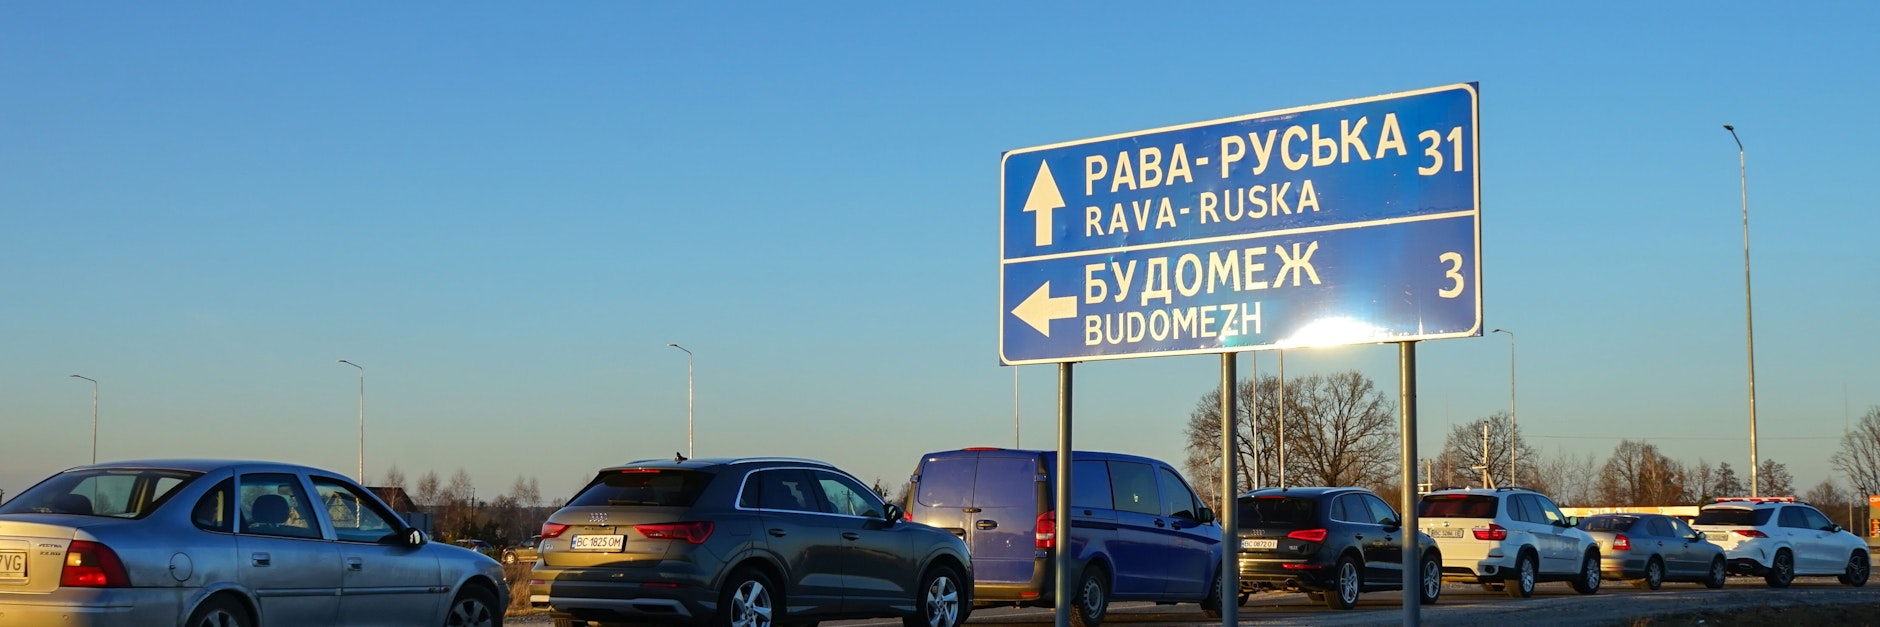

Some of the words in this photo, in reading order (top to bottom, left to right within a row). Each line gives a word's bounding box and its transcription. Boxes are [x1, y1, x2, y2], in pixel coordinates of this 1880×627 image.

[1417, 126, 1463, 177] 31
[1085, 240, 1321, 306] БУДОМЕЖ
[1438, 251, 1465, 299] 3
[1085, 301, 1262, 346] BUDOMEZH
[576, 537, 588, 547] BC
[590, 537, 607, 547] 1825
[608, 537, 622, 547] OM
